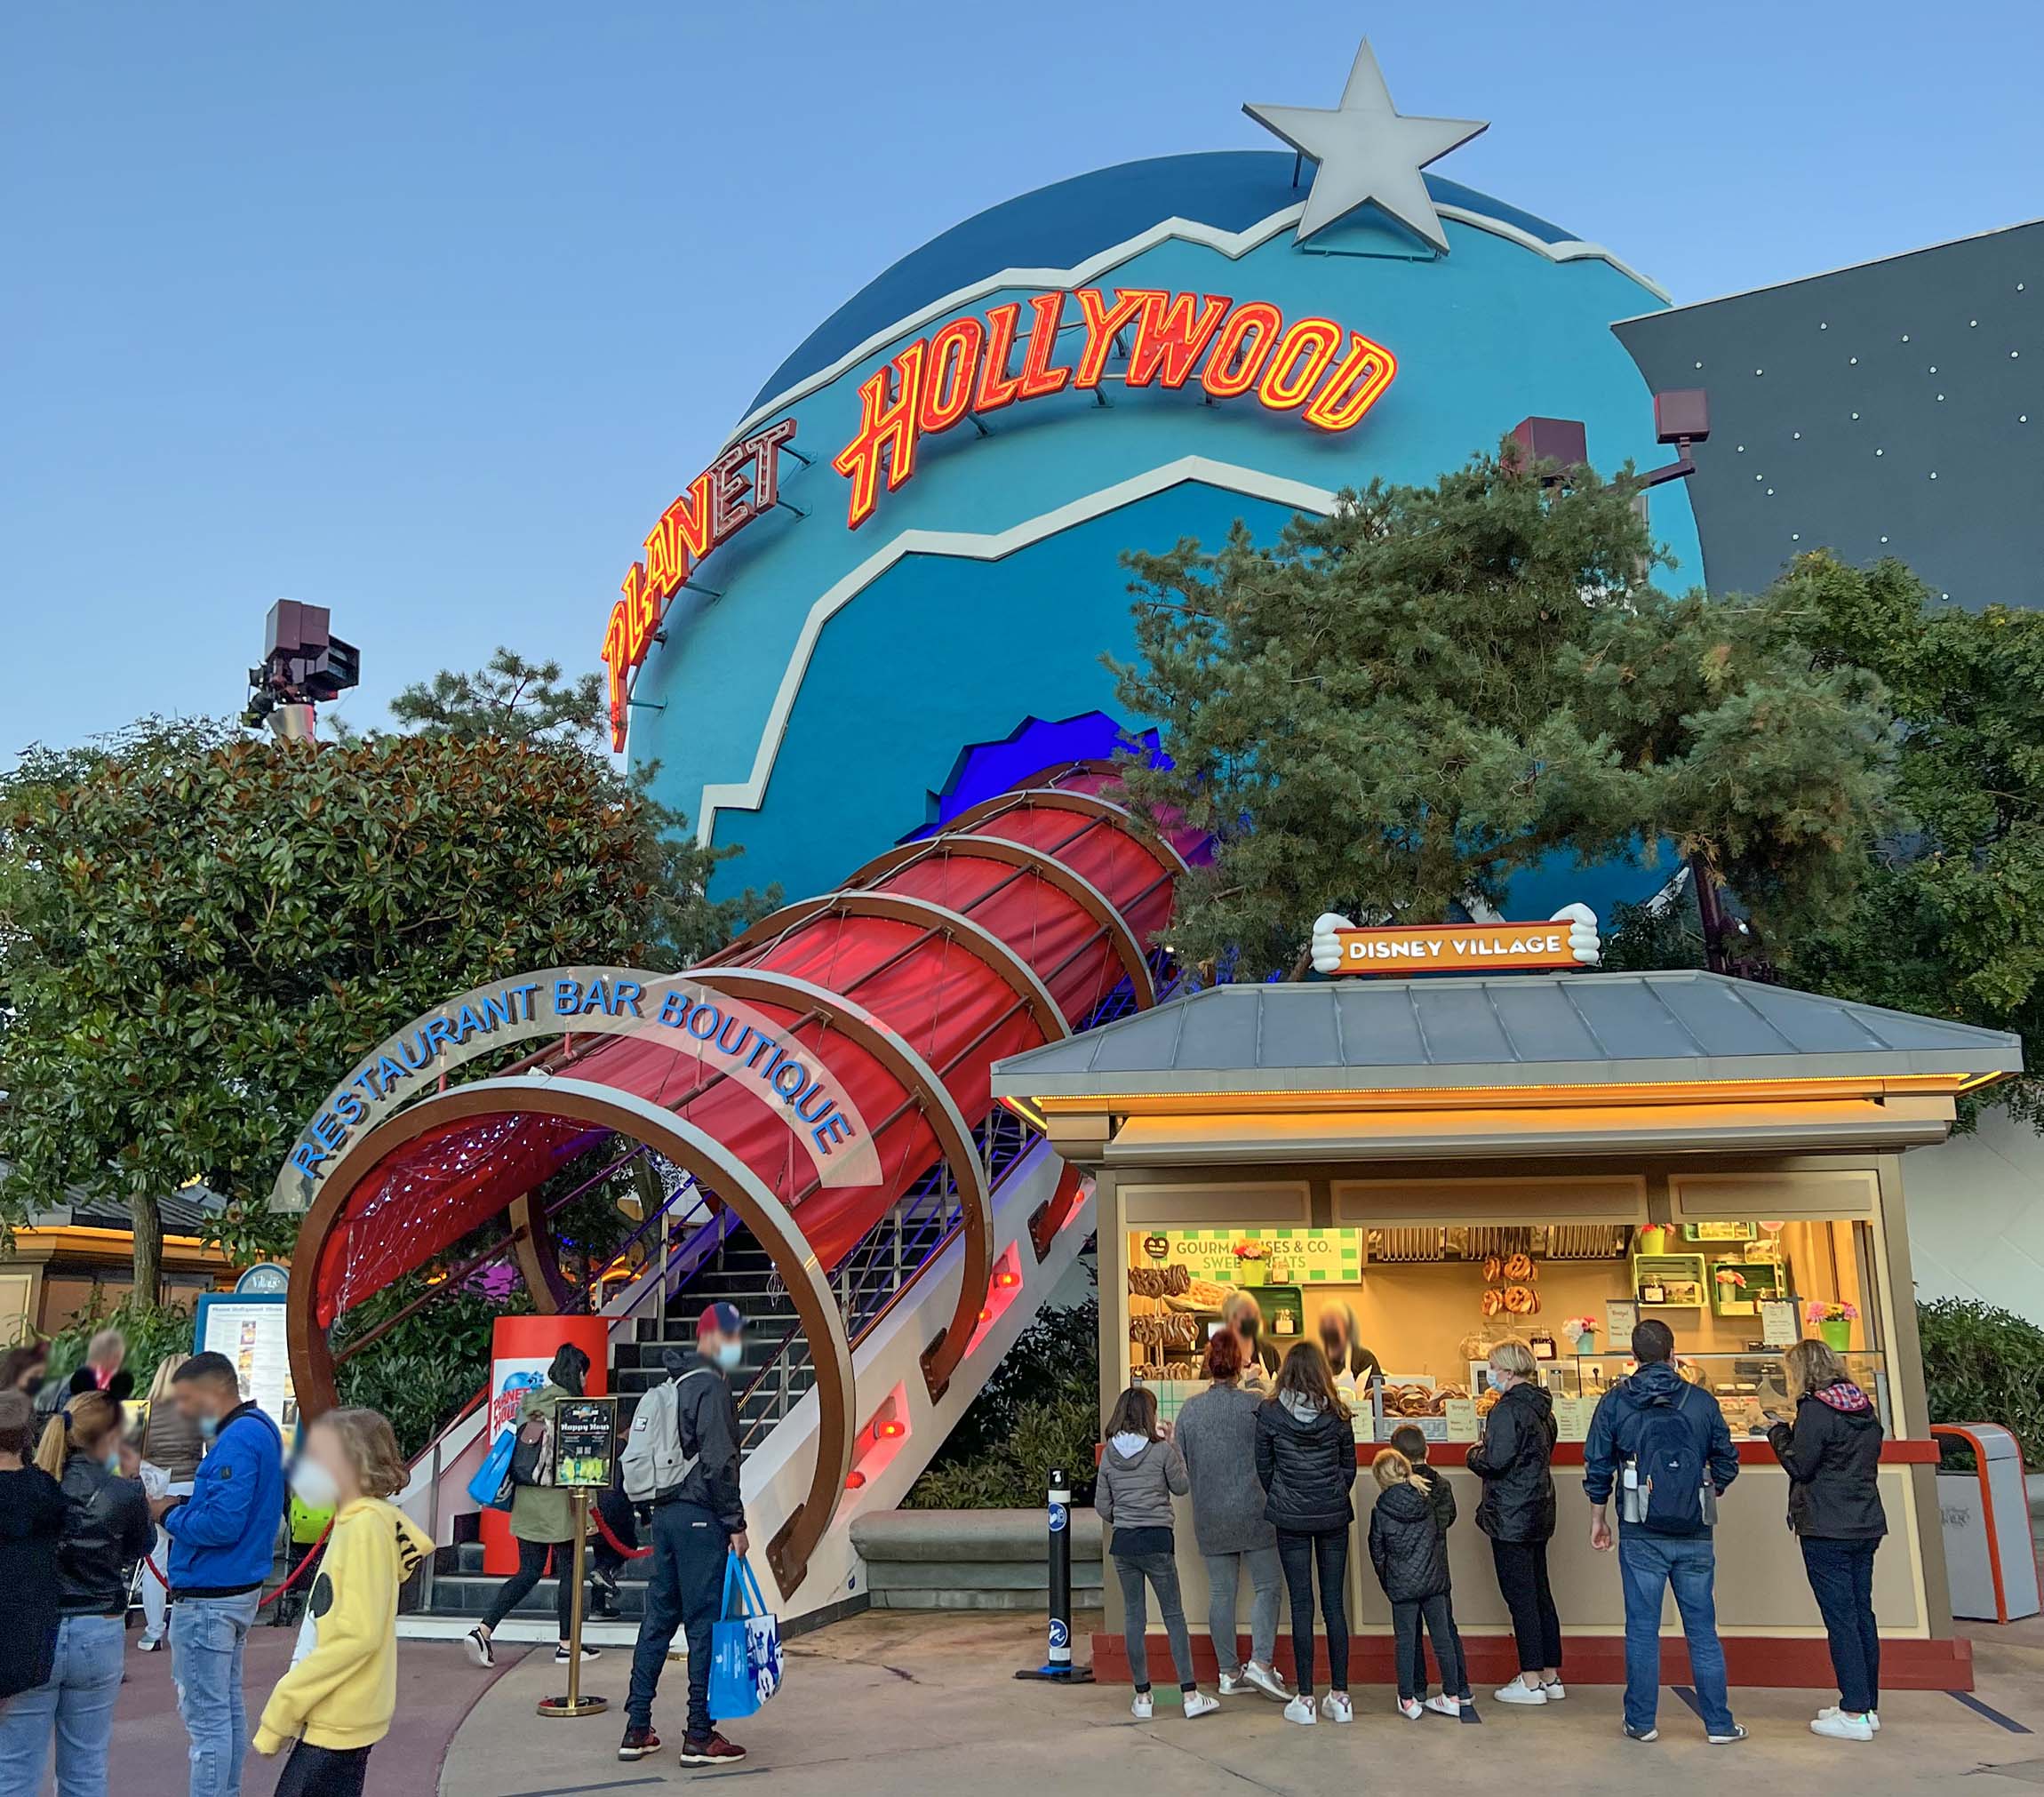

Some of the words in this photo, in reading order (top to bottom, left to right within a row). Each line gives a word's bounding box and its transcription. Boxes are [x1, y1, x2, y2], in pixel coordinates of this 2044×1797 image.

[601, 417, 796, 754] PLANET
[832, 288, 1399, 531] HOLLYWOOD
[1349, 938, 1443, 960] DISNEY
[1450, 934, 1562, 956] VILLAGE
[289, 981, 539, 1182] RESTAURANT
[553, 978, 643, 1018] BAR
[657, 990, 851, 1156] BOUTIQUE
[1176, 1241, 1289, 1255] GOURMSES
[1294, 1241, 1304, 1253] &
[1307, 1240, 1332, 1253] CO.
[1202, 1257, 1243, 1269] SWEE
[1264, 1255, 1306, 1268] REATS
